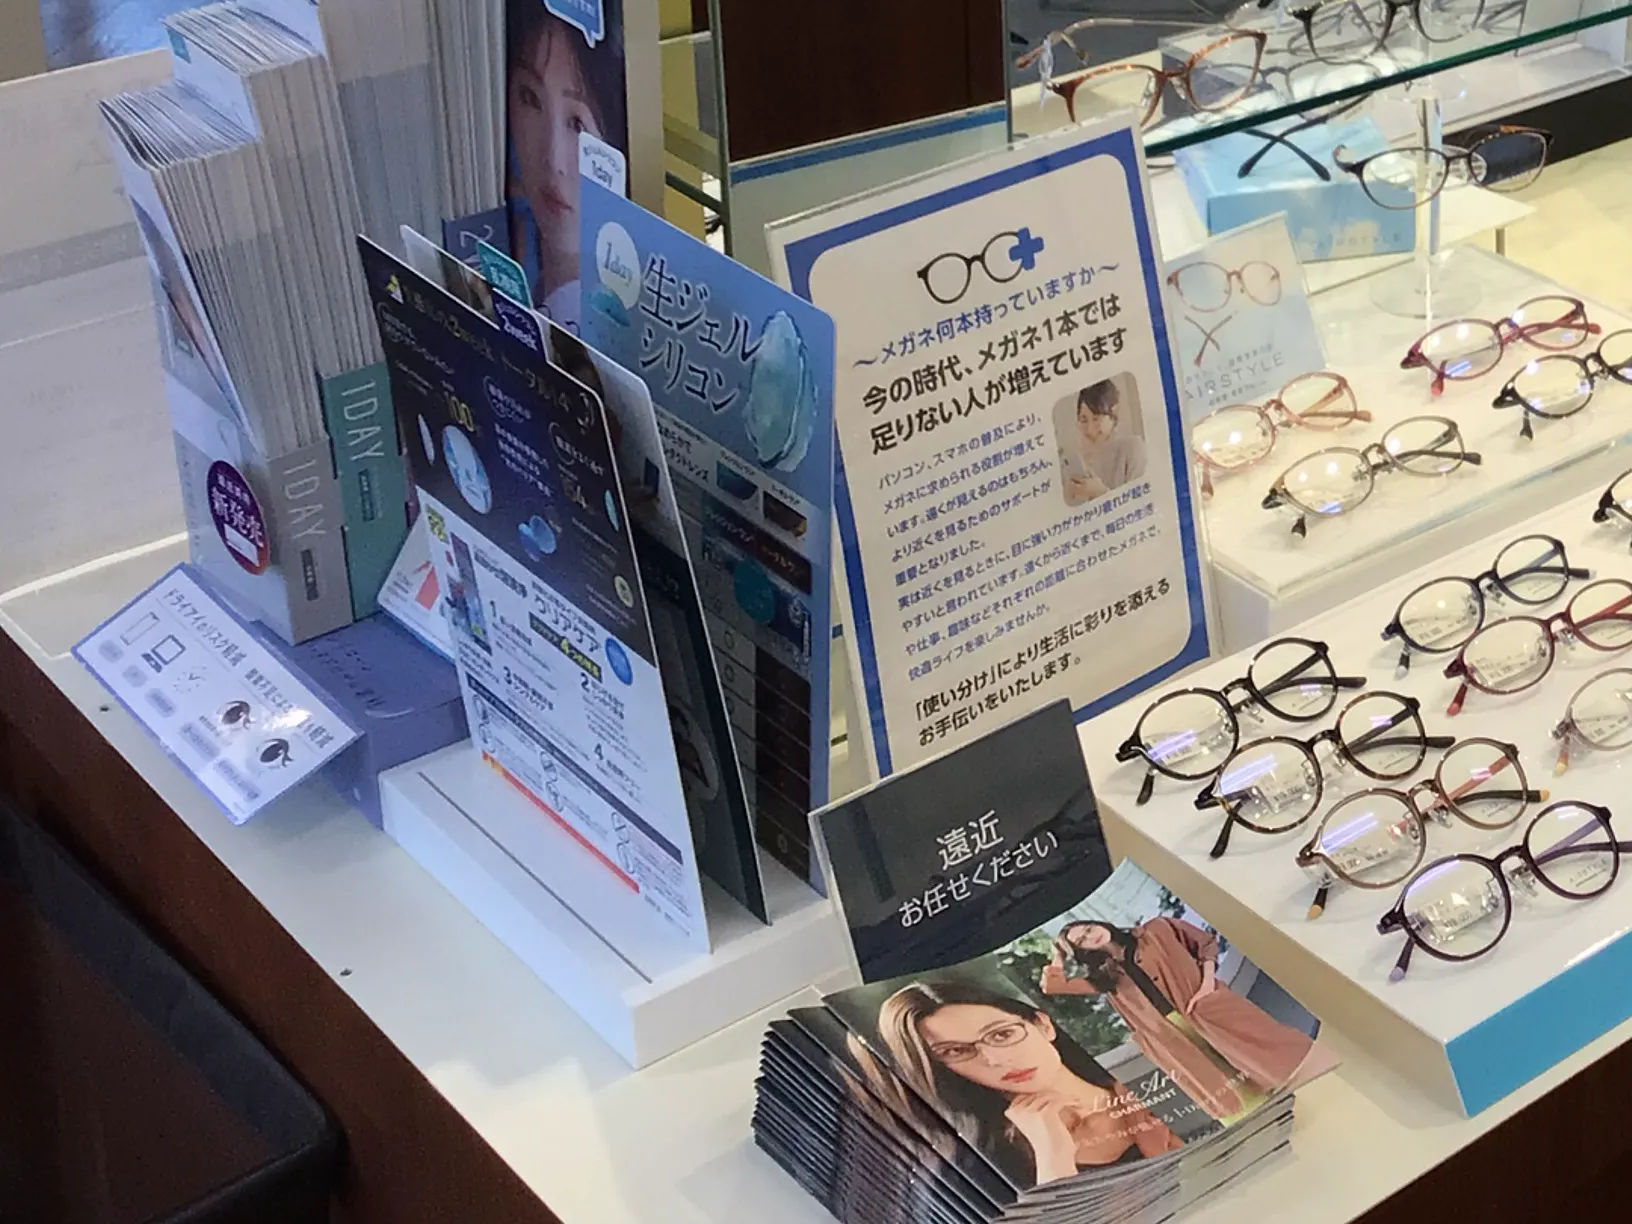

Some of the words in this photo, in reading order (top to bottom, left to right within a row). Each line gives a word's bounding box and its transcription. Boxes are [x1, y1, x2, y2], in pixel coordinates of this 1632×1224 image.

[640, 251, 763, 363] 生ジェル
[639, 326, 741, 413] シリコン
[862, 293, 1121, 415] 今の時代、メガネ1本では
[870, 327, 1127, 454] 足りない人が増えています
[340, 380, 386, 464] 1DAY
[282, 458, 328, 540] 1DAY
[884, 433, 1046, 515] メガネに求められる役割が増えて
[212, 486, 265, 549] 新発売
[892, 477, 1052, 563] より近くを見るためのサポートが
[895, 537, 986, 587] 重要となりました。
[908, 602, 1051, 682] 快適ライフを楽しみませんか。
[915, 577, 1171, 722] 「使い分け」により生活に彩りを添える
[919, 651, 1082, 747] お手伝いをいたします。
[898, 831, 1059, 927] お任せください
[936, 809, 1004, 871] 遠近
[1088, 1089, 1139, 1115] Line
[1132, 1068, 1183, 1101] Art
[1108, 1087, 1178, 1120] CHARMANT
